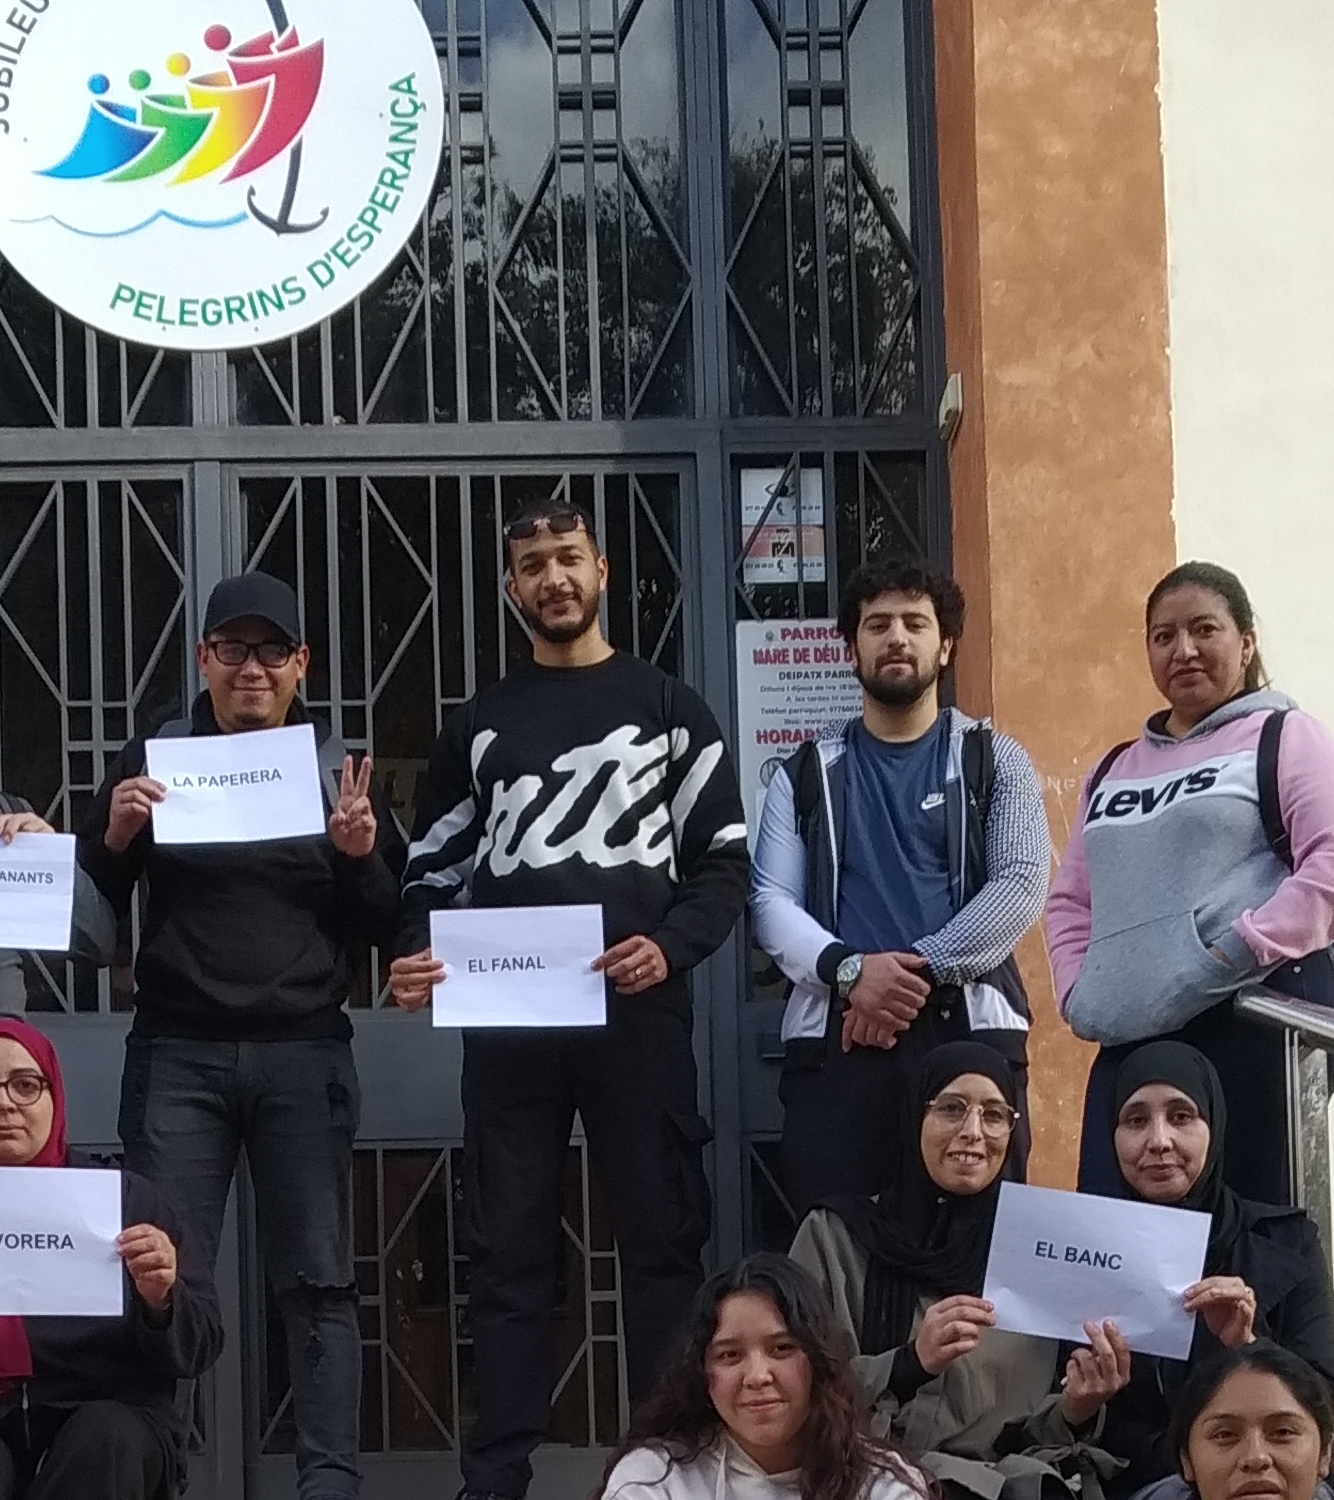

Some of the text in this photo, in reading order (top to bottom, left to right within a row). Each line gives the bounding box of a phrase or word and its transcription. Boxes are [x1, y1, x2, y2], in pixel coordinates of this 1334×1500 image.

[109, 72, 427, 327] PELEGRINS D'ESPERANÇA
[752, 648, 789, 665] MARE
[793, 647, 811, 664] DE
[755, 728, 821, 744] HORAR
[173, 768, 282, 788] LA PAPERERA
[468, 956, 546, 974] EL FANAL
[1035, 1241, 1123, 1270] EL BANC
